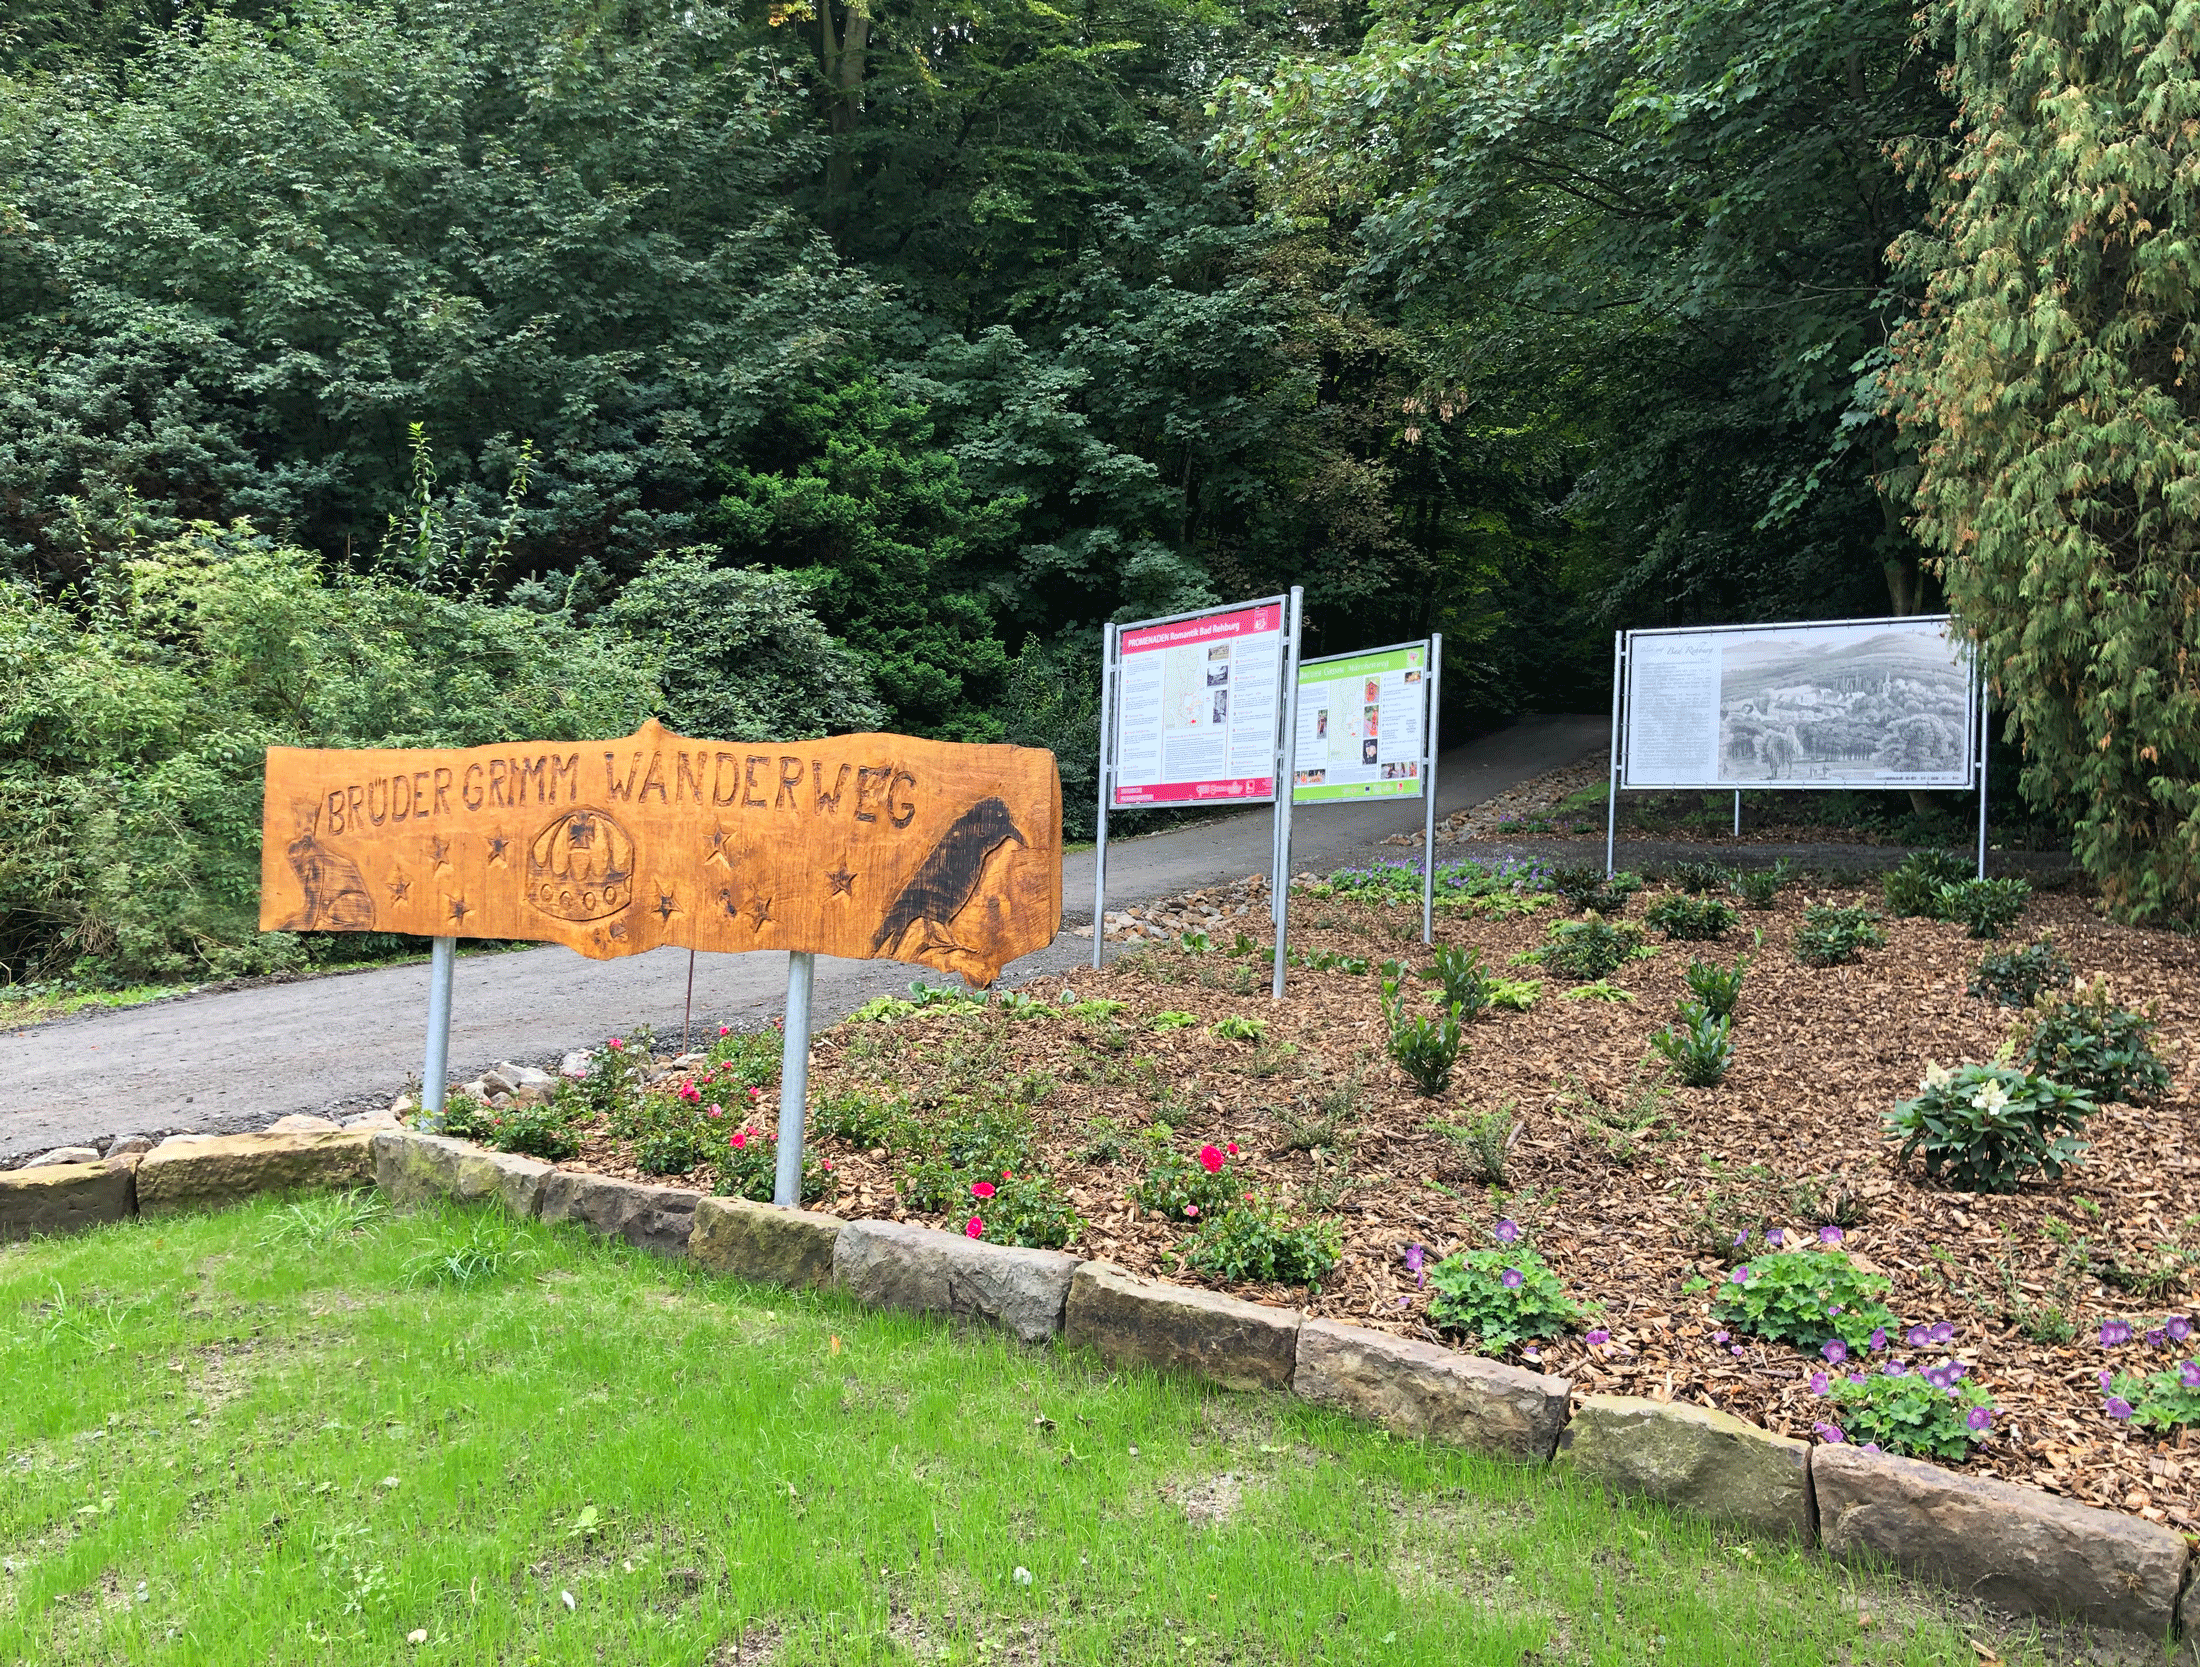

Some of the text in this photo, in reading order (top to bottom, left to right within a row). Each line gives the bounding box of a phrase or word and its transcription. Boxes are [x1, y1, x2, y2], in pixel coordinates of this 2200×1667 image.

[1127, 622, 1240, 648] PROMENADEN Romantik Bad Rehburg
[328, 750, 917, 837] BRÜDER GRIMM WANDERWEG
